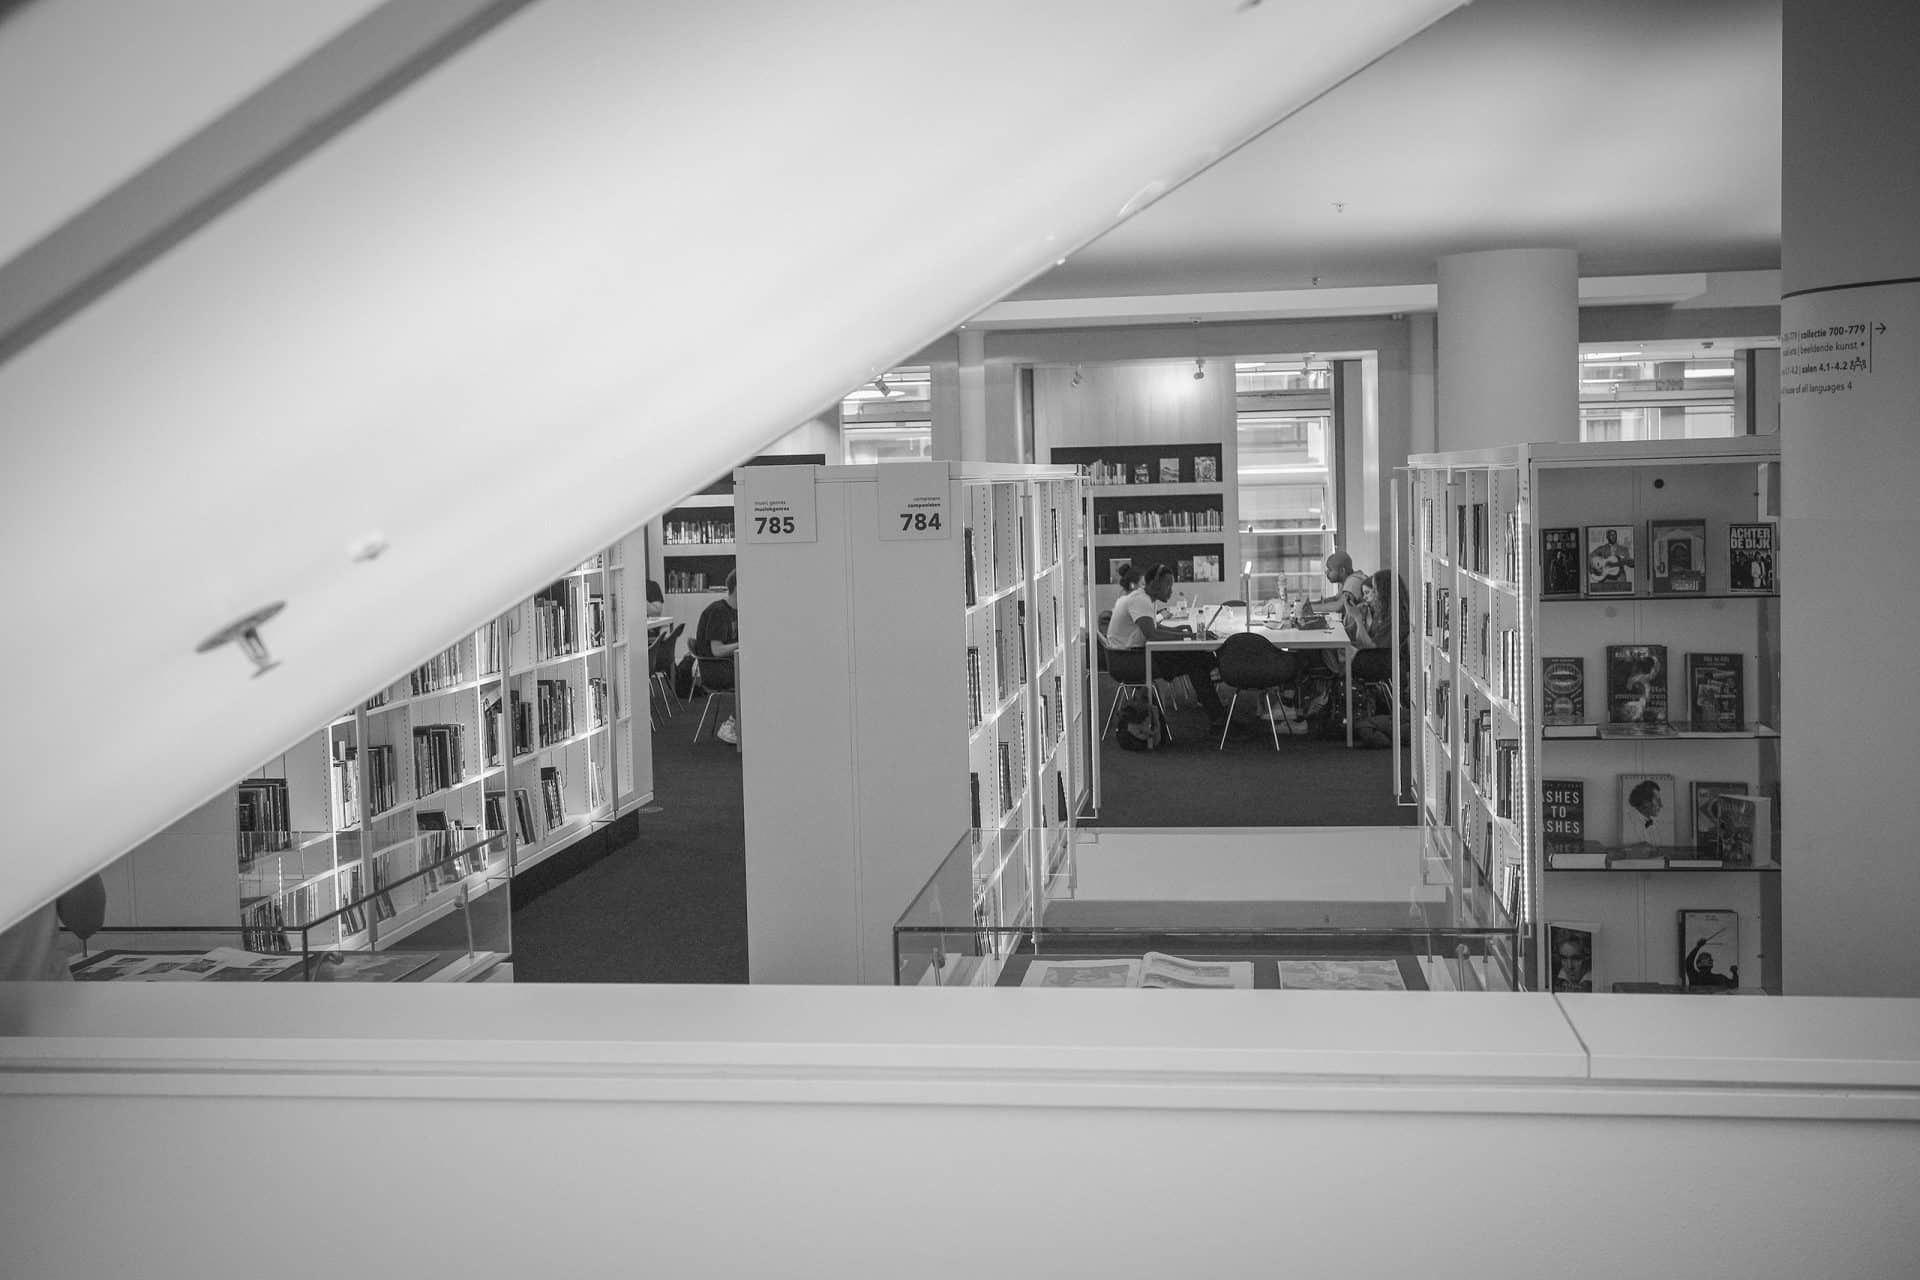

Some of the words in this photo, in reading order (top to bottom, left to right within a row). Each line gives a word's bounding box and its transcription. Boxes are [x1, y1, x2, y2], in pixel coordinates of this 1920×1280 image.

[1800, 328, 1827, 339] collectie
[1829, 324, 1866, 336] 700-779
[1836, 341, 1858, 351] kunst
[1809, 383, 1845, 395] languages
[755, 516, 795, 535] 785
[900, 513, 942, 531] 784
[1730, 527, 1771, 539] ACHTER
[1730, 538, 1744, 549] DE
[1745, 538, 1771, 549] DIJK
[1542, 790, 1580, 804] SHES
[1551, 806, 1567, 818] TO
[1542, 820, 1580, 834] SHES
